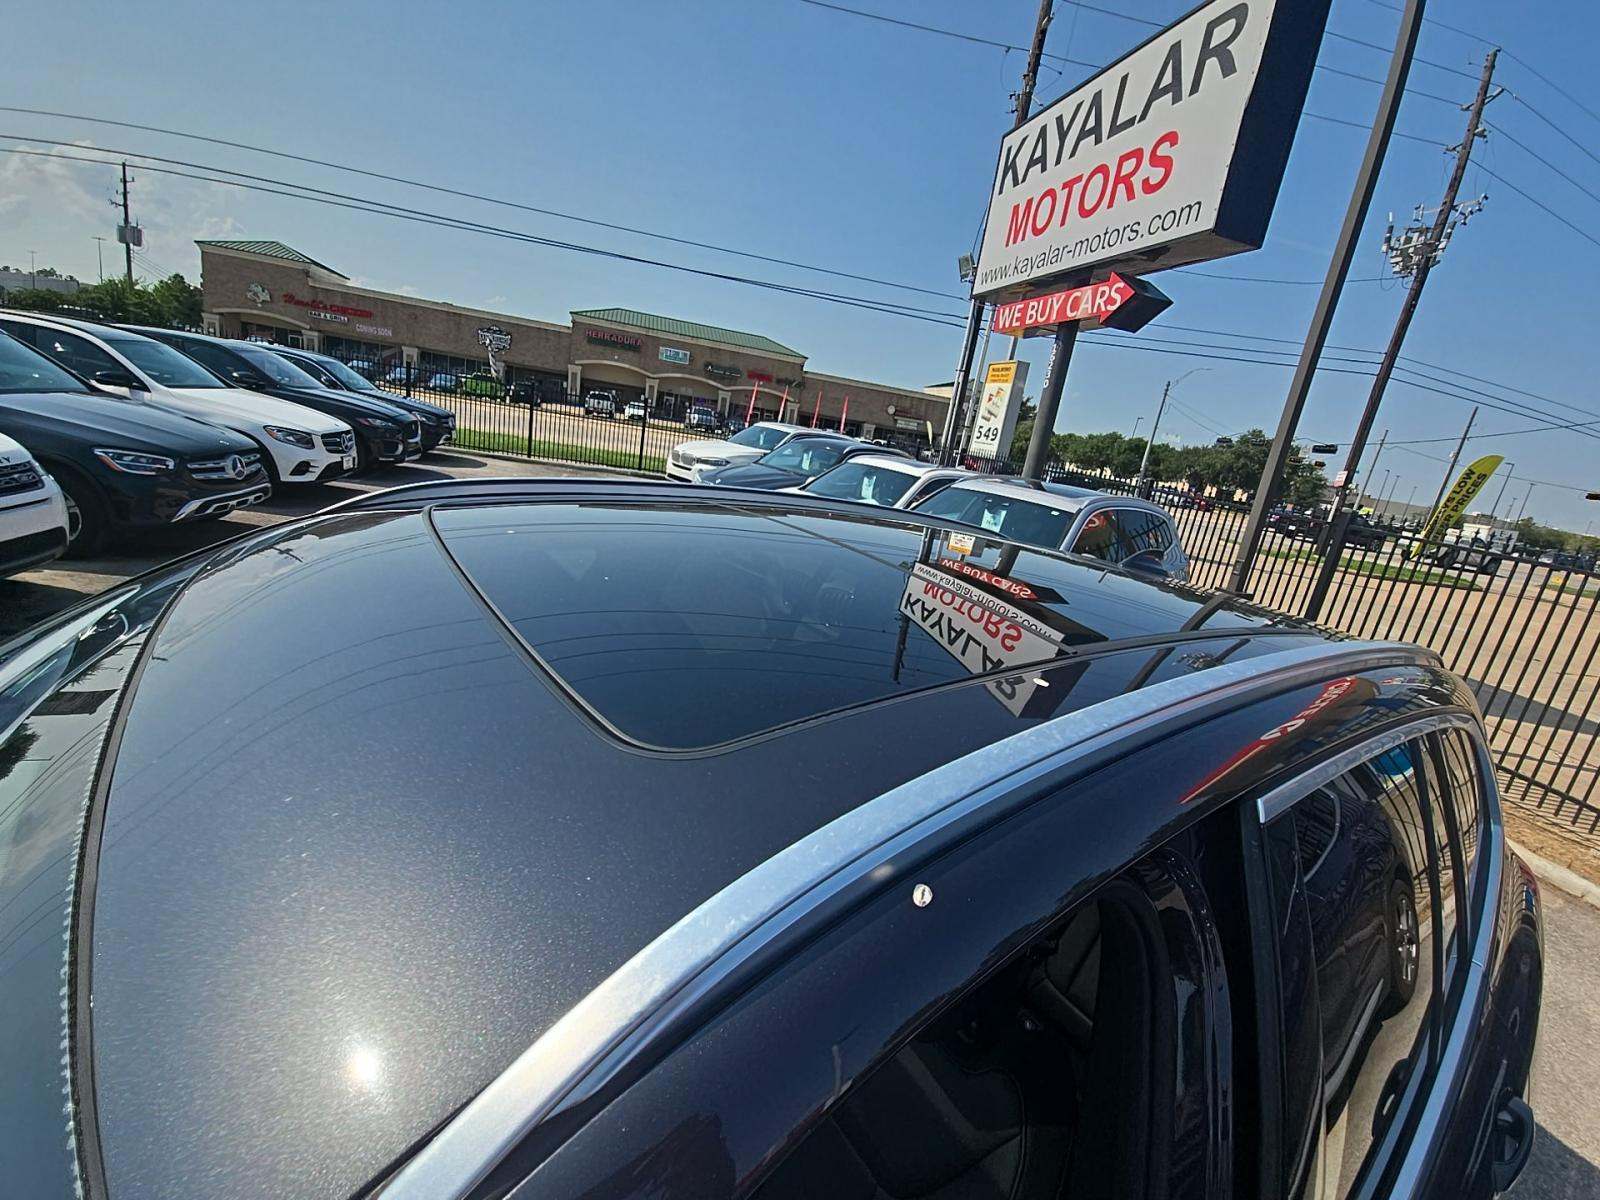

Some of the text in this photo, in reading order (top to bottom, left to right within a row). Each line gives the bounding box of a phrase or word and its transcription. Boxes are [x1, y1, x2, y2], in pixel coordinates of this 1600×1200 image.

[998, 2, 1249, 195] KAYALAR
[1005, 130, 1179, 248] MOTORS
[980, 200, 1202, 286] www.kayalar-motors.com
[999, 281, 1126, 328] WE BUY CARS
[975, 425, 999, 442] 549
[1450, 472, 1488, 513] PRICES
[1453, 468, 1476, 494] LOW
